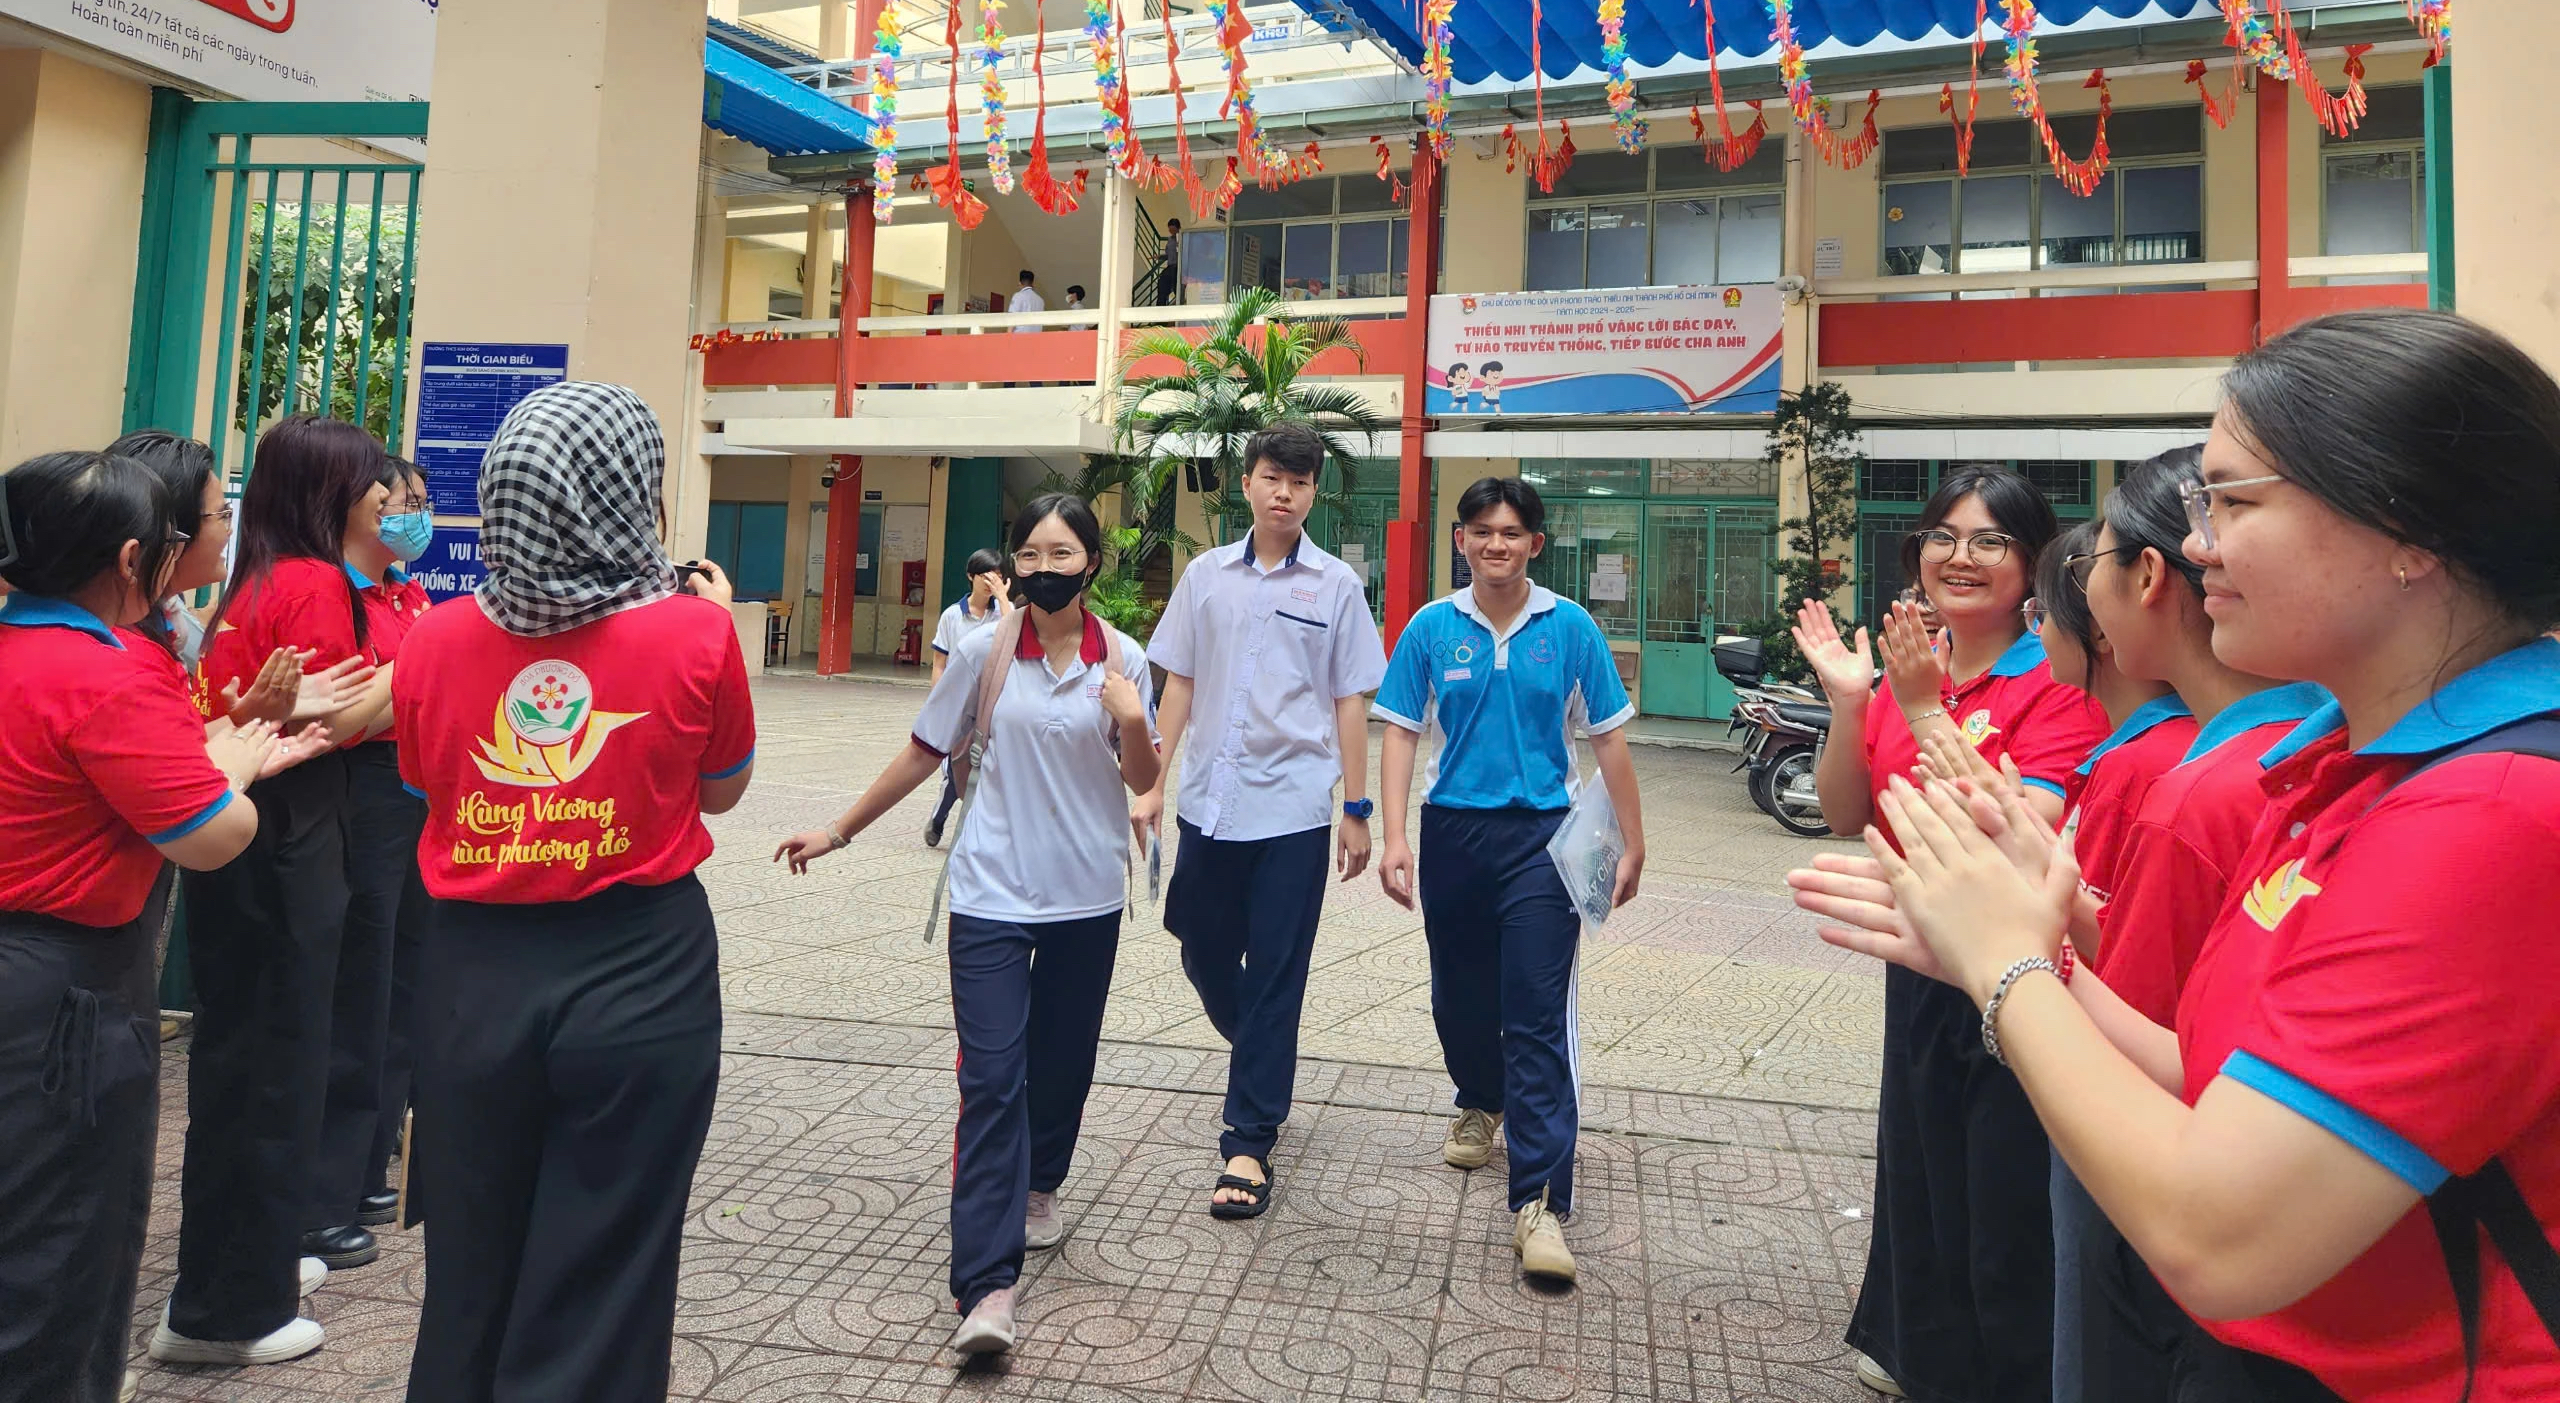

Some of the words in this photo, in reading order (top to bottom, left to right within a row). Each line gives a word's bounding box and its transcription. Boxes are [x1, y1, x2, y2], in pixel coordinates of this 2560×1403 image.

[71, 0, 109, 28] Hoàn
[113, 17, 143, 40] toàn
[147, 32, 179, 54] miễn
[182, 46, 204, 62] phí
[131, 3, 162, 25] 24/7
[165, 15, 183, 35] tất
[185, 26, 200, 41] cả
[203, 33, 224, 51] các
[227, 43, 256, 66] ngày
[258, 54, 289, 79] trong
[291, 67, 319, 89] tuần.
[1560, 296, 1583, 304] PHONG
[1659, 290, 1673, 300] PHỐ
[1698, 291, 1717, 299] MINH
[1590, 306, 1608, 314] 2024
[1464, 321, 1500, 337] THIẾU
[1504, 325, 1526, 336] NHI
[1530, 321, 1573, 335] THÀNH
[1577, 318, 1604, 334] PHỐ
[1608, 319, 1645, 333] VÂNG
[1648, 318, 1669, 331] LỜI
[1672, 317, 1700, 331] BÁC
[1703, 318, 1737, 333] DẠY,
[1454, 341, 1473, 355] TỰ
[1474, 340, 1501, 353] HÀO
[1504, 336, 1555, 353] TRUYỀN
[1558, 335, 1607, 353] THỐNG,
[1610, 334, 1642, 351] TIẾP
[1644, 335, 1681, 349] BƯỚC
[1684, 336, 1713, 348] CHA
[1716, 336, 1746, 348] ANH
[456, 353, 480, 364] THỜI
[482, 355, 507, 364] GIAN
[509, 353, 534, 364] BIỂU
[448, 542, 471, 561] VUI
[459, 574, 477, 592] XE
[456, 790, 526, 835] Hùng
[531, 792, 616, 829] Vương
[496, 834, 592, 873] phượng
[597, 826, 633, 857] đỏ
